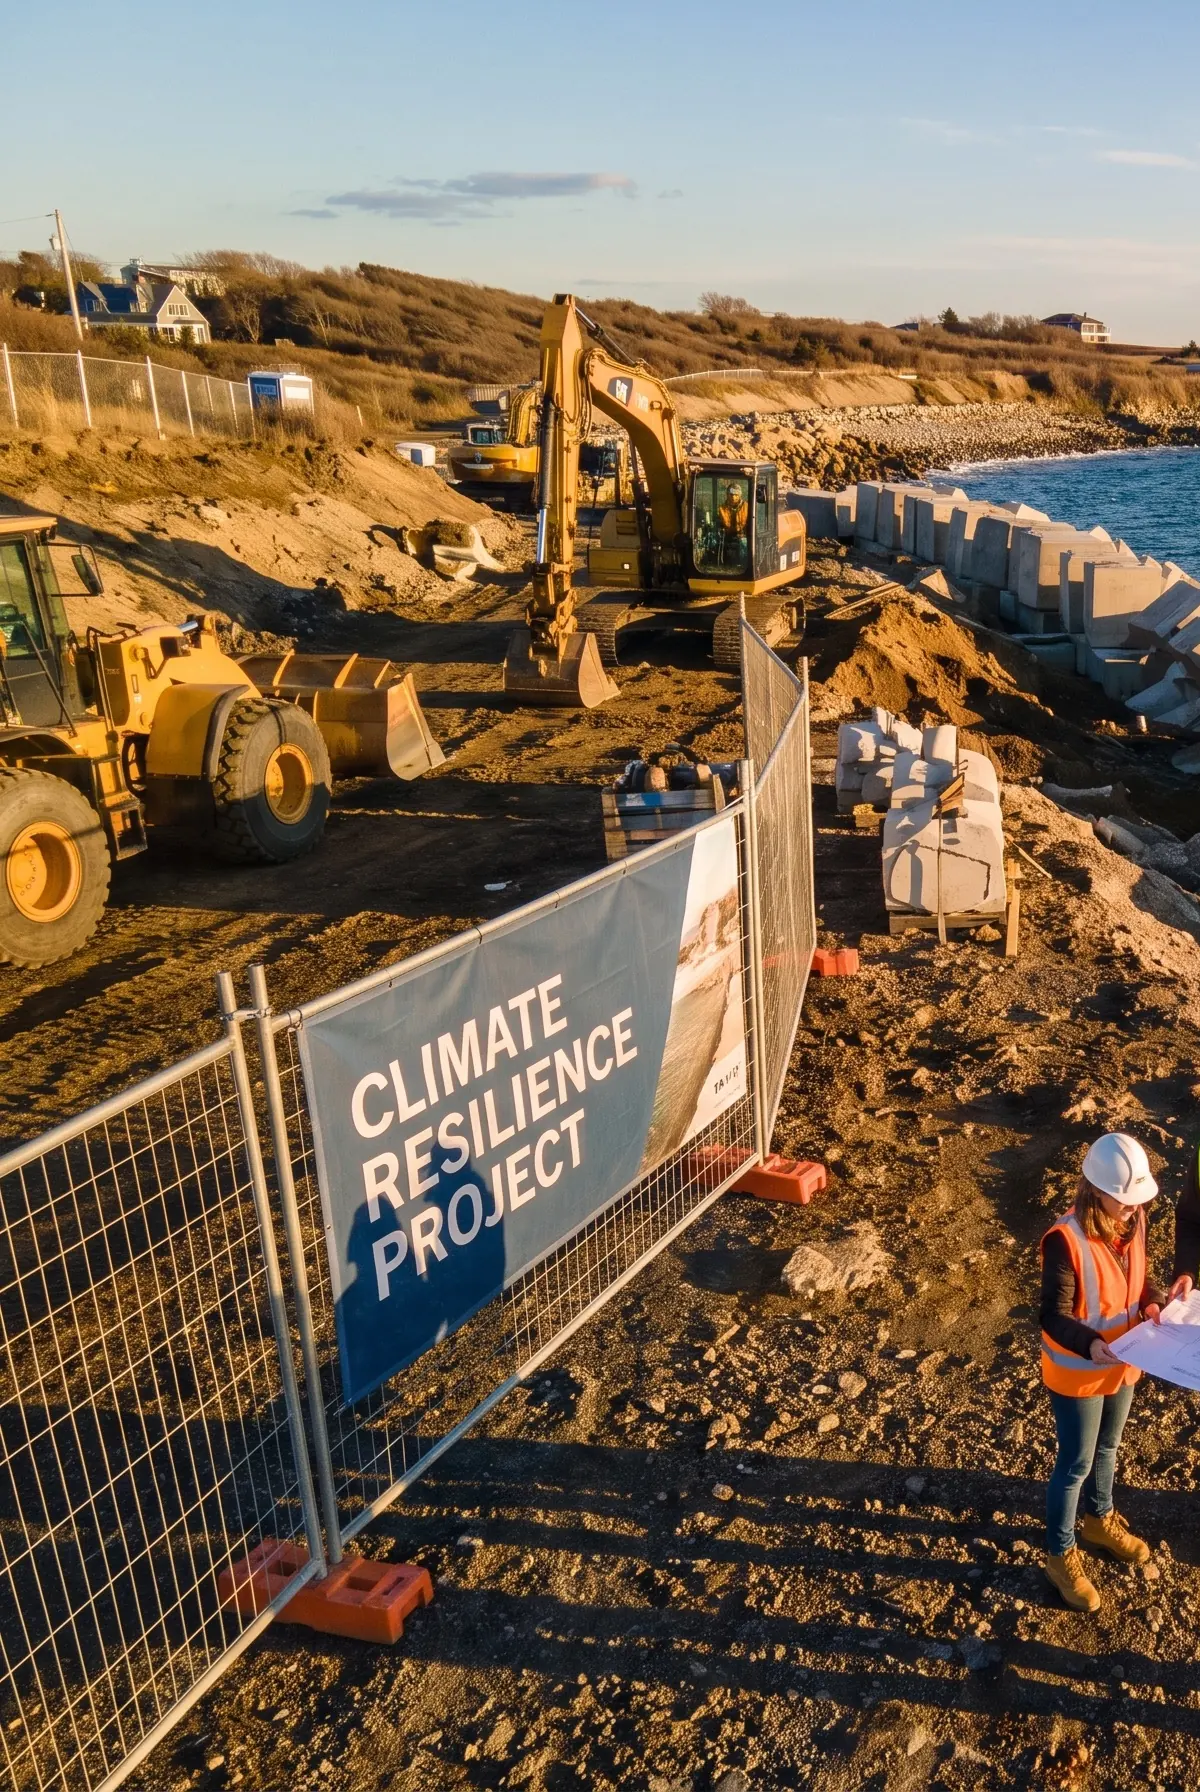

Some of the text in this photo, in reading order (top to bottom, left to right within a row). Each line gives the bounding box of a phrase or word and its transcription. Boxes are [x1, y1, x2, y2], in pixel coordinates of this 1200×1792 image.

[351, 973, 568, 1138] CLIMATE
[362, 1007, 638, 1223] RESILIENCE
[371, 1108, 585, 1301] PROJECT
